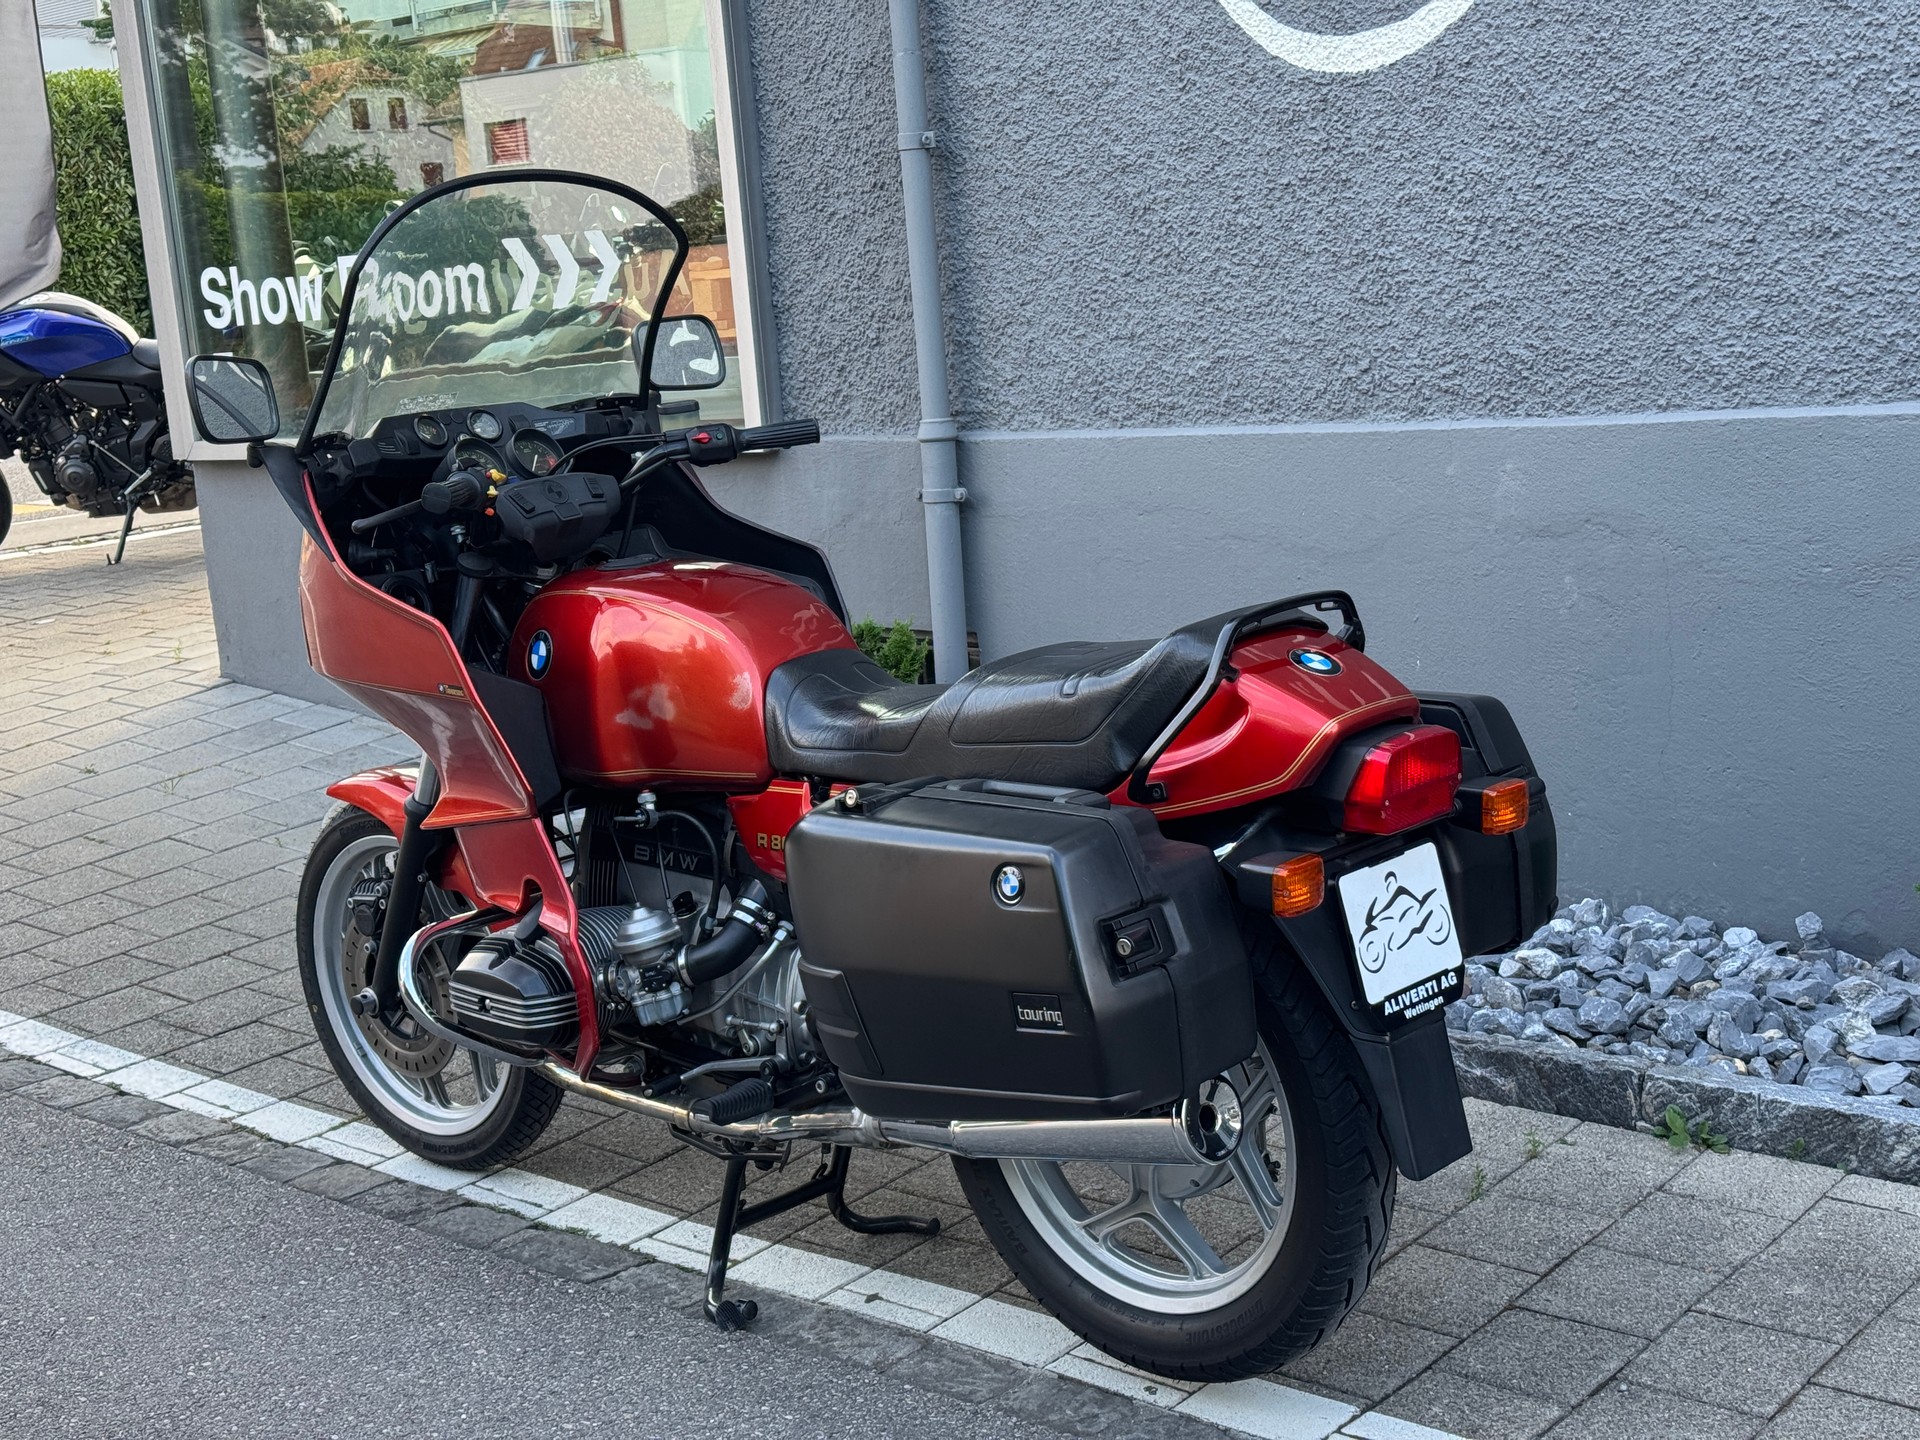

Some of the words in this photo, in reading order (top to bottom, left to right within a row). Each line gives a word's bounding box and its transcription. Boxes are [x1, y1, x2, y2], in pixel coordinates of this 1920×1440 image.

[200, 266, 323, 330] Show
[757, 832, 768, 848] R
[634, 844, 699, 872] BMW
[1384, 979, 1439, 1016] ALIVERTI
[1440, 971, 1458, 990] AG
[1017, 1005, 1064, 1026] touring
[1403, 995, 1445, 1020] Wettingen
